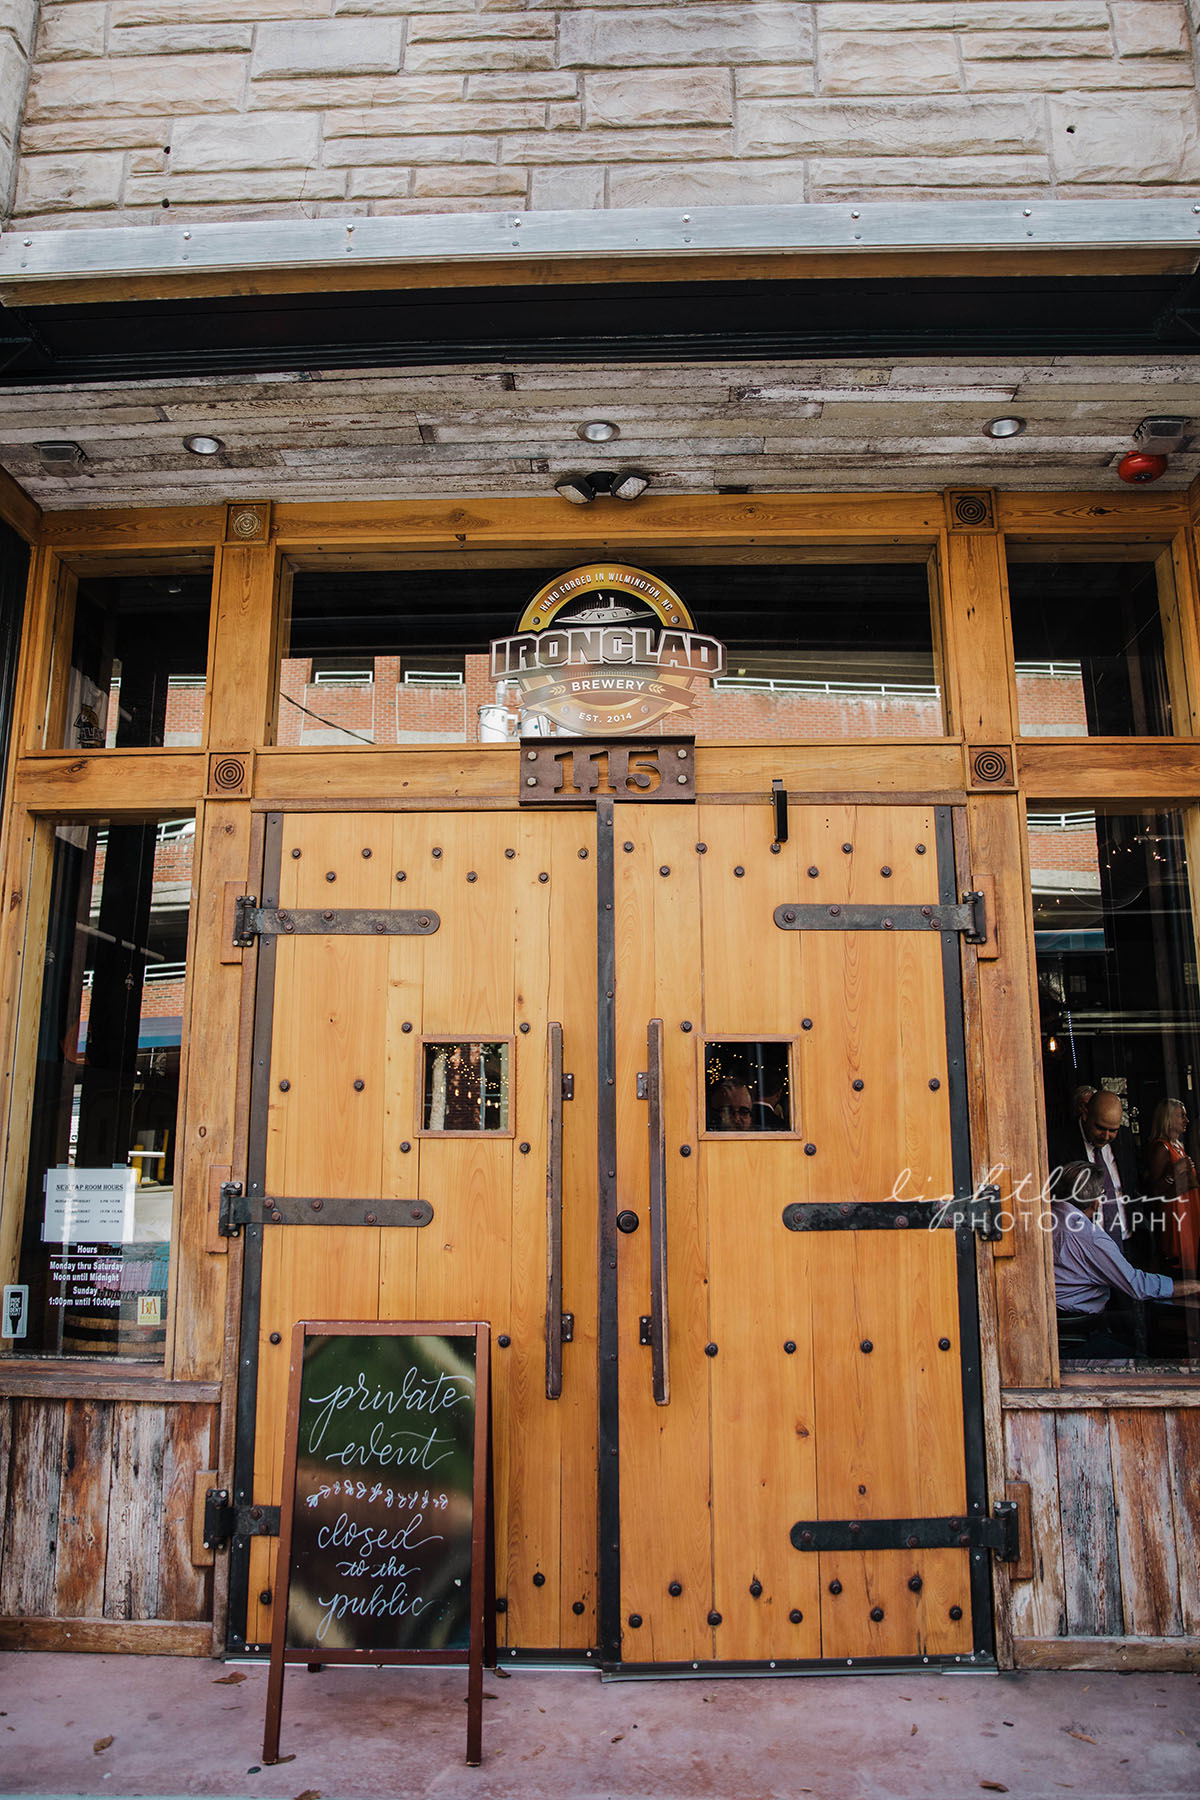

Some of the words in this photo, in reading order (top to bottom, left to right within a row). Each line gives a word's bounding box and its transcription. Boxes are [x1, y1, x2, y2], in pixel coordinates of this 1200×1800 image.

[540, 591, 560, 612] HAND
[560, 574, 592, 596] FORGED
[595, 572, 605, 582] IN
[609, 572, 661, 602] WILMINGTON,
[661, 599, 674, 612] NC
[491, 628, 723, 677] IRONCLAD
[571, 679, 645, 691] BREWERY
[579, 712, 602, 723] EST.
[607, 712, 632, 723] 2014
[553, 750, 662, 794] 115
[77, 1245, 98, 1254] Hours
[50, 1261, 76, 1272] Monday
[77, 1261, 91, 1270] thru
[93, 1262, 123, 1272] Saturday
[53, 1273, 71, 1281] Noon
[72, 1273, 88, 1281] until
[90, 1273, 119, 1283] Midnight
[49, 1297, 73, 1307] 1:00pm
[75, 1297, 91, 1306] until
[93, 1297, 121, 1308] 10:00pm
[73, 1286, 98, 1296] Sunday
[308, 1366, 474, 1454] private
[325, 1421, 457, 1470] event
[318, 1512, 444, 1557] closed
[335, 1559, 370, 1577] to
[370, 1555, 421, 1578] the
[316, 1582, 434, 1641] public
